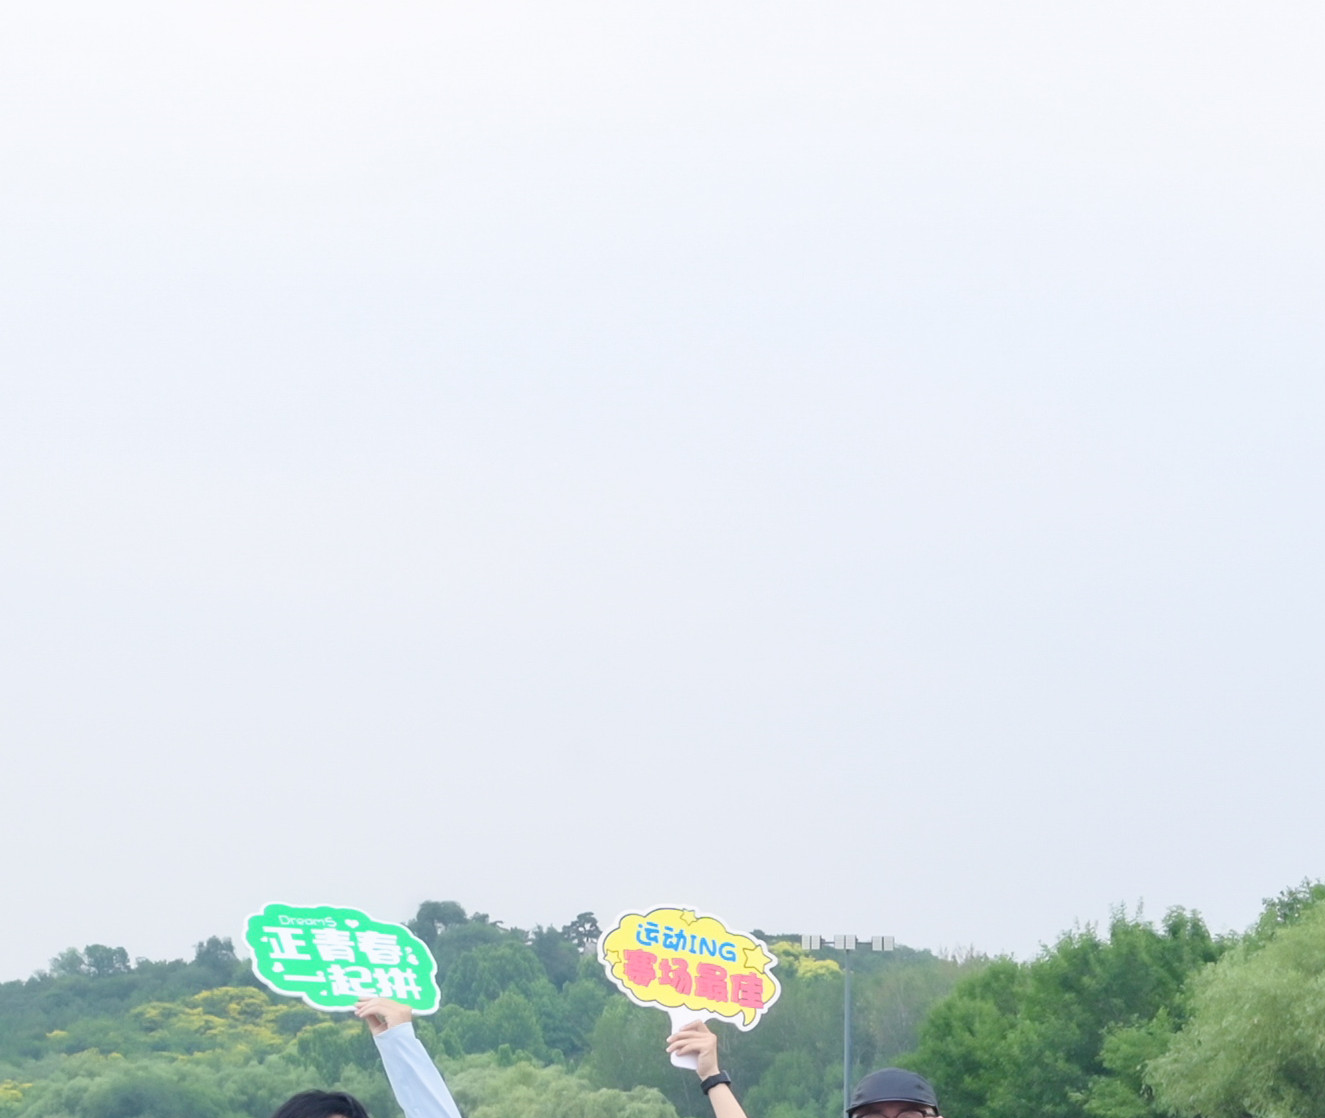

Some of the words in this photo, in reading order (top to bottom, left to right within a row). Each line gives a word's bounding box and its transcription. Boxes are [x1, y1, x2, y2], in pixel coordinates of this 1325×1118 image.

[262, 926, 402, 965] 正青春
[636, 922, 737, 962] 运动ING
[283, 964, 423, 1000] 一起拼
[623, 949, 764, 1009] 赛场最佳
